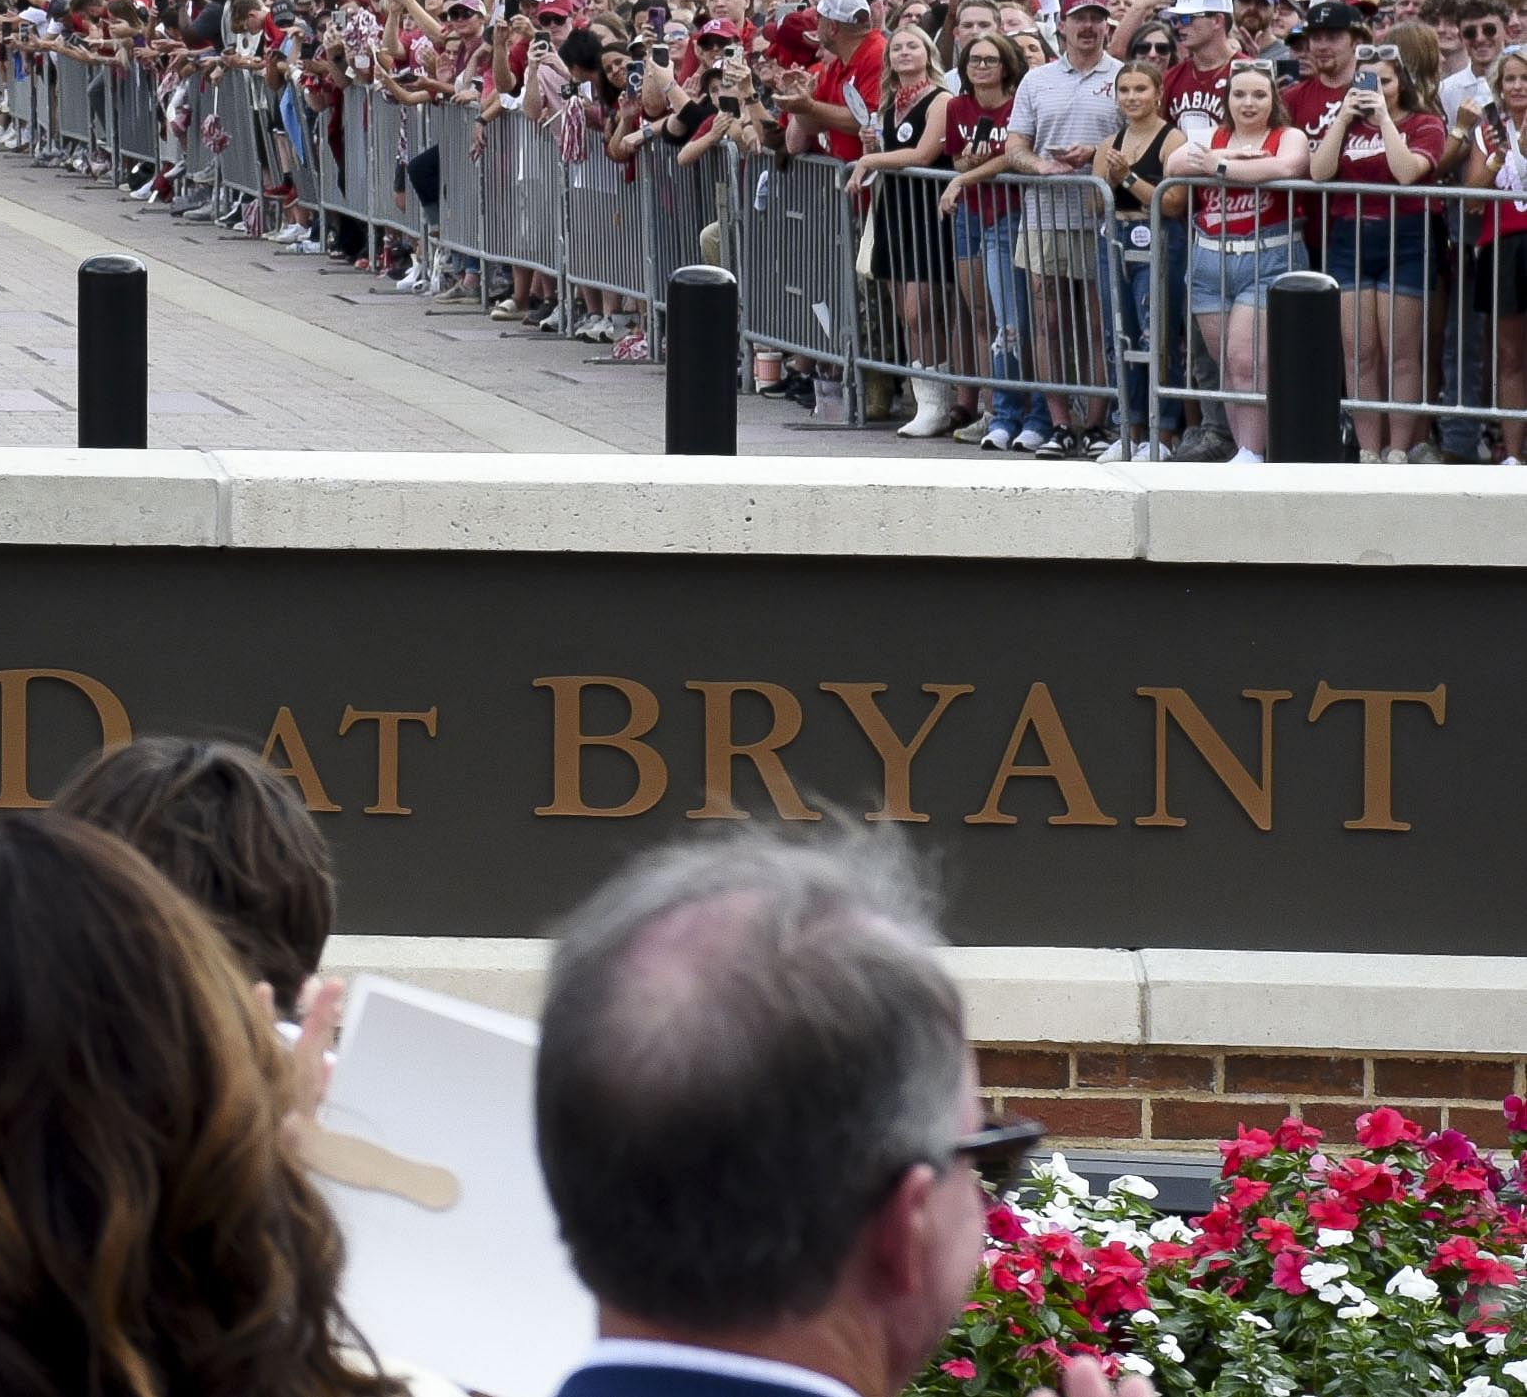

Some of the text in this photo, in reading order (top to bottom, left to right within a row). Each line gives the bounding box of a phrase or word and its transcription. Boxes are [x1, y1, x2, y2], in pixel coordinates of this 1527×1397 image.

[1093, 82, 1114, 98] A
[258, 705, 439, 816] AT
[532, 674, 1447, 832] BRYANT
